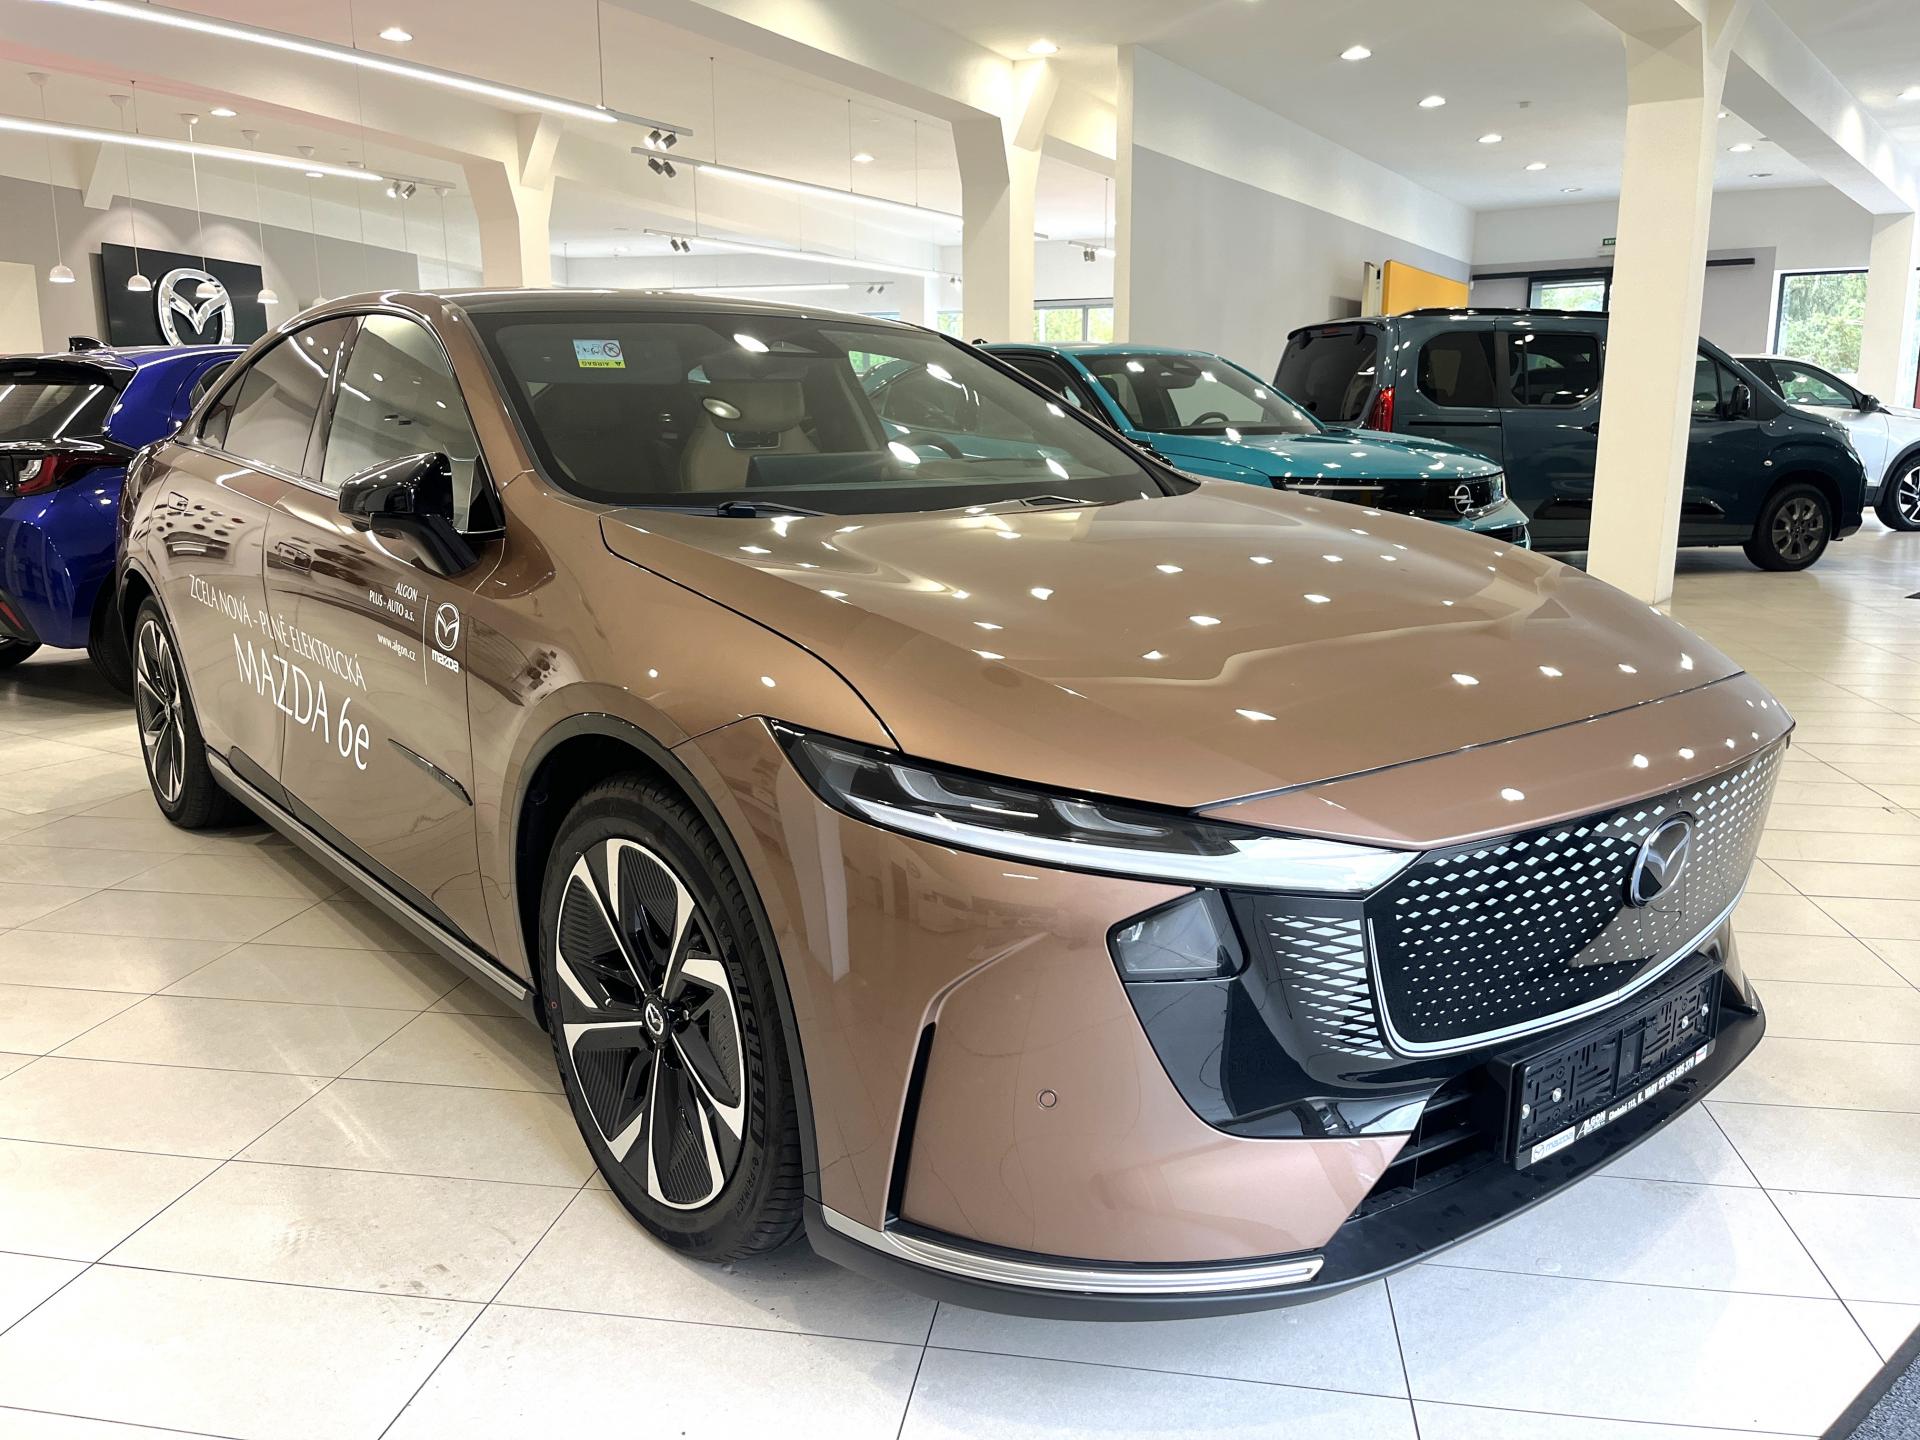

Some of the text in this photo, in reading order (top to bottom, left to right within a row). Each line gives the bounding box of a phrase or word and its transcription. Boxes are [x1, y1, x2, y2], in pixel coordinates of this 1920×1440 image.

[369, 590, 383, 607] PLUS
[387, 598, 404, 617] AUTO
[404, 609, 415, 622] a.s.
[394, 582, 418, 602] ALGON
[189, 574, 219, 611] ZCELA
[219, 595, 252, 628] NOVÁ
[258, 613, 290, 648] PLNĚ
[289, 625, 367, 692] ELEKTRICKÁ
[377, 633, 416, 661] www.algon.cz
[233, 632, 370, 770] MAZDA 6e
[729, 961, 765, 1150] MICHELIN
